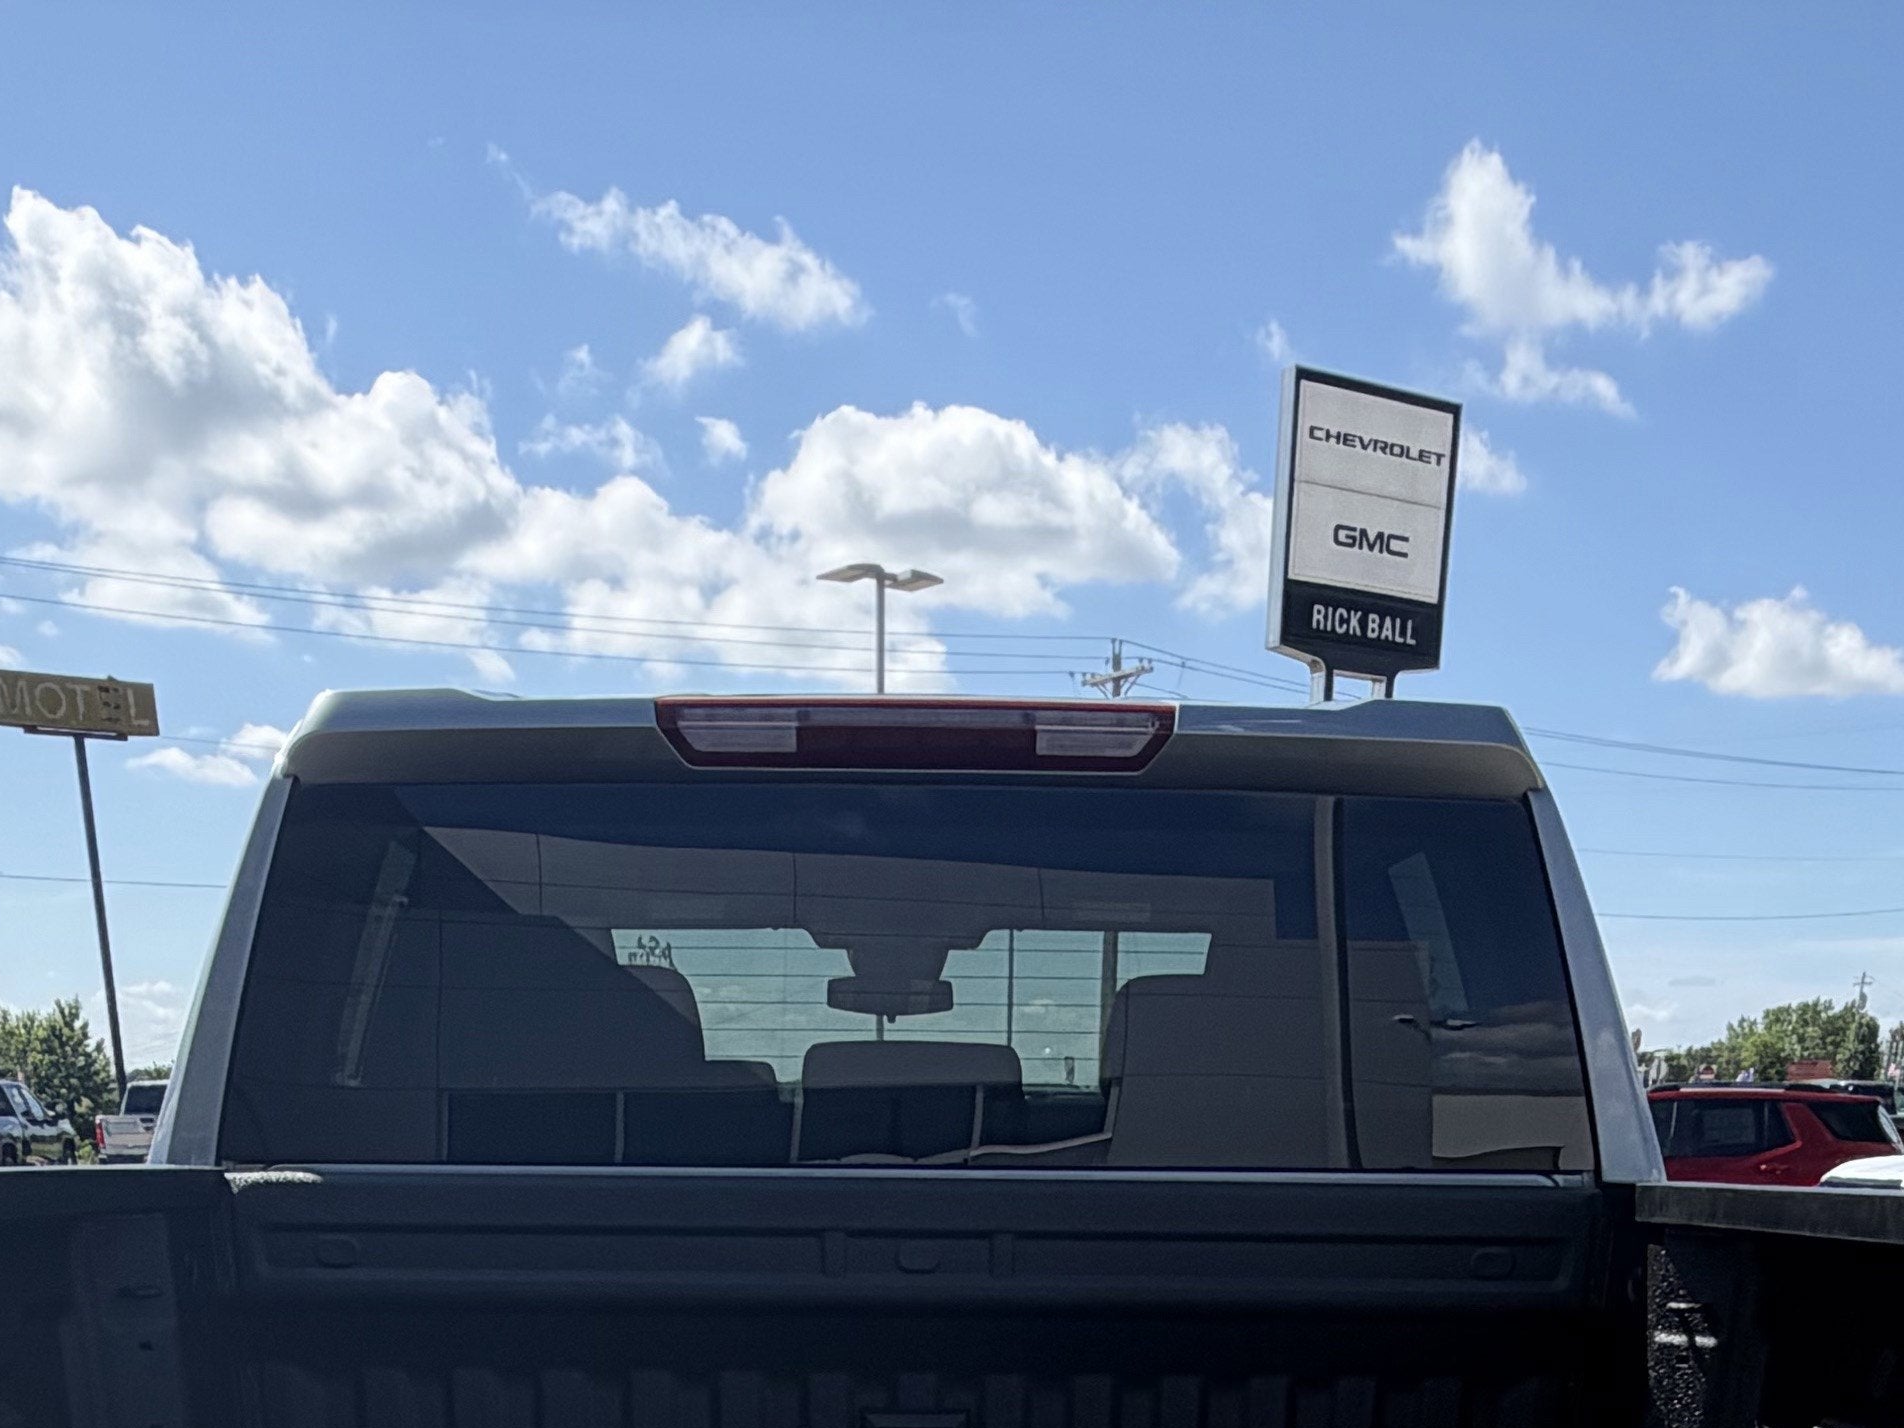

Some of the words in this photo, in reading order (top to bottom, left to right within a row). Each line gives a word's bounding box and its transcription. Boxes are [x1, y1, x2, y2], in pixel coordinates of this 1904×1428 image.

[1308, 424, 1446, 467] CHEVROLET
[1332, 523, 1410, 559] GMC
[1311, 603, 1361, 637] RICK
[1367, 613, 1417, 645] BALL
